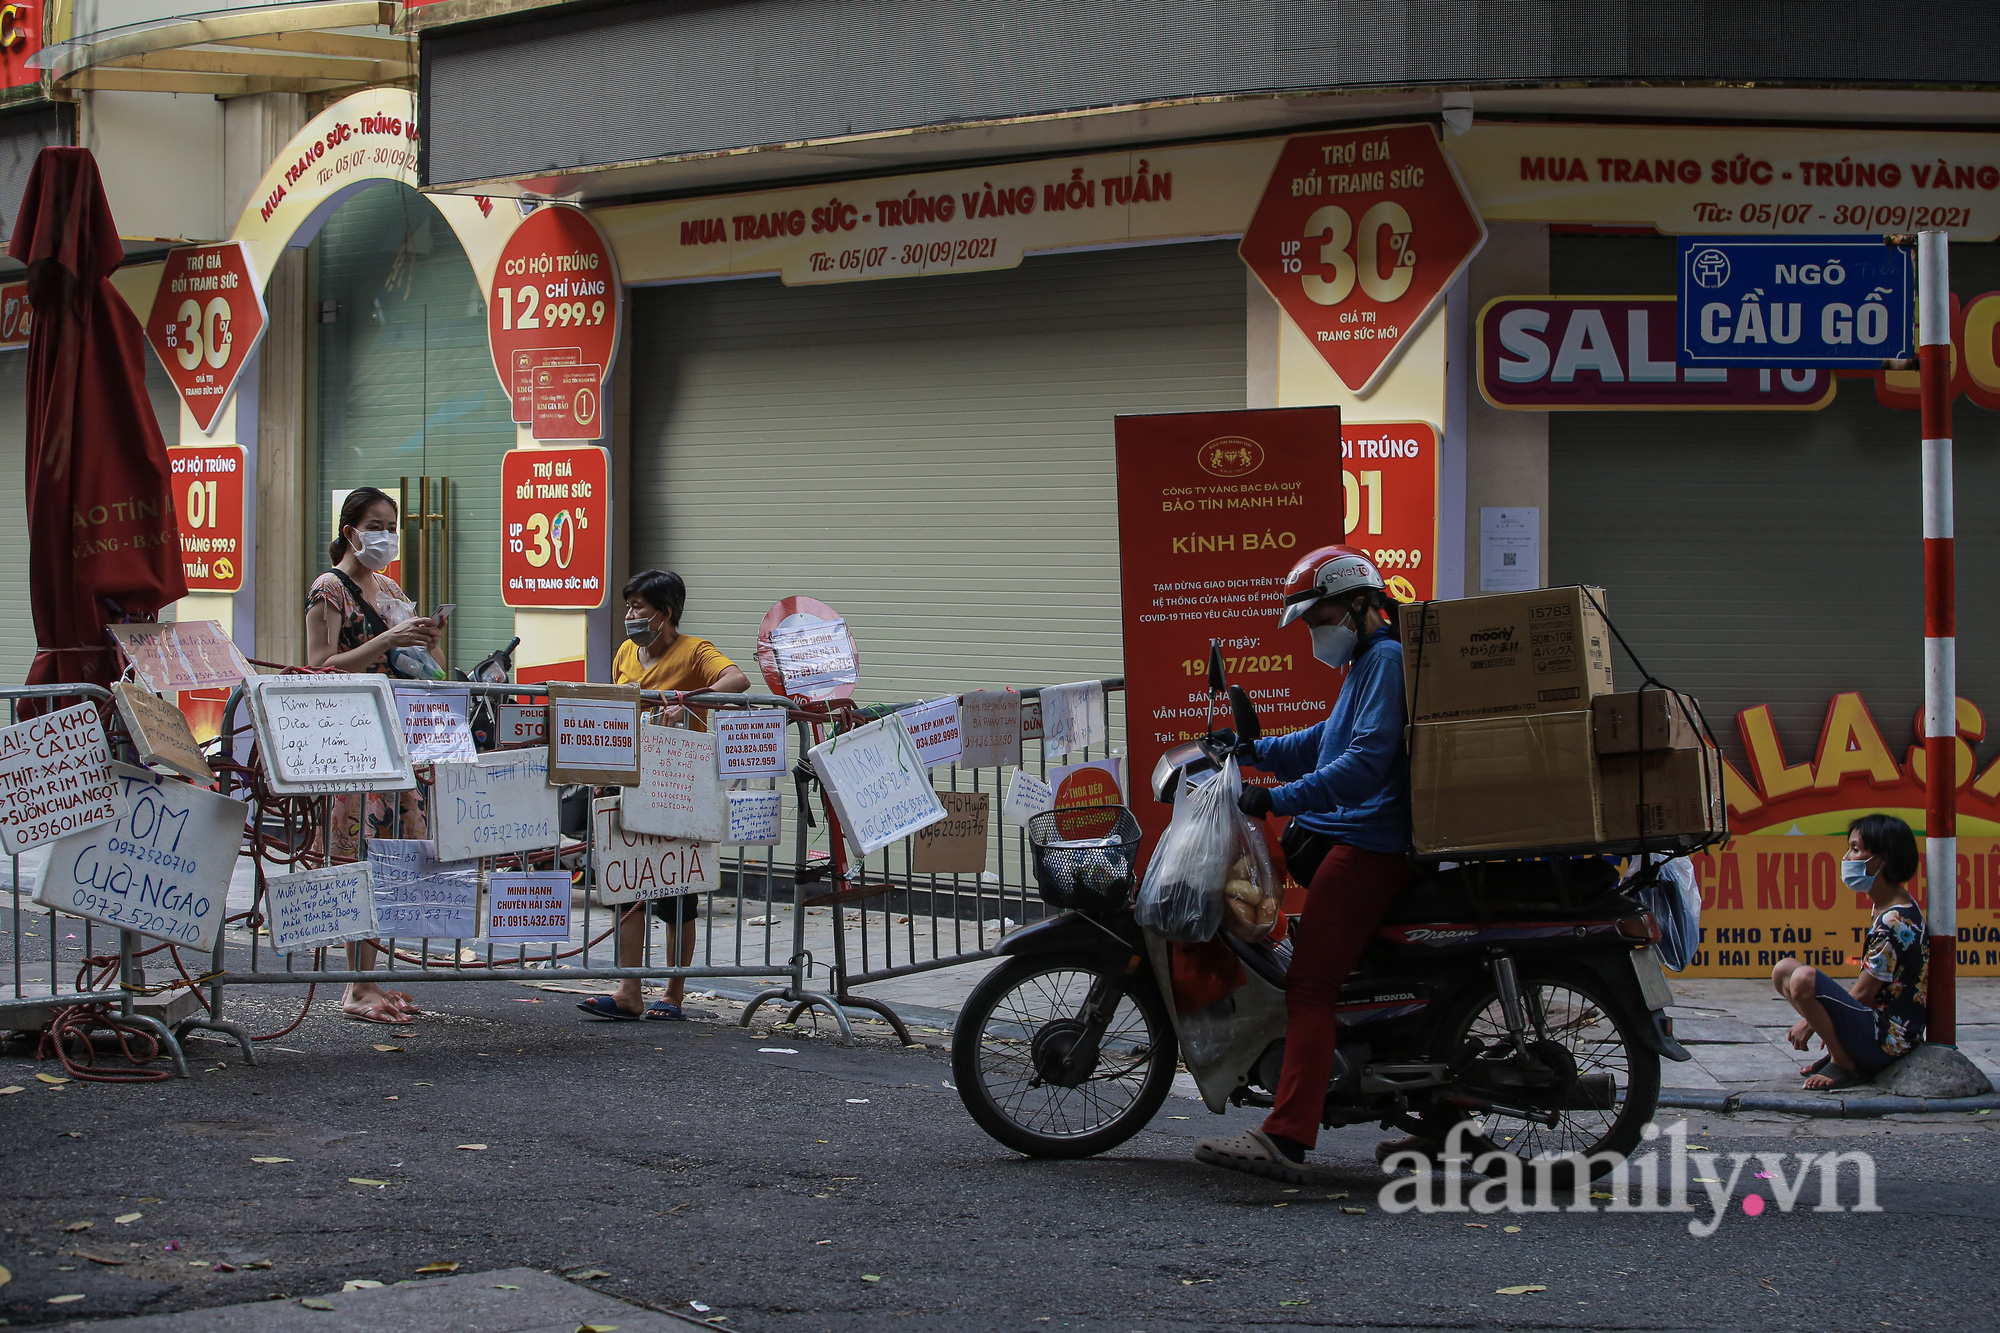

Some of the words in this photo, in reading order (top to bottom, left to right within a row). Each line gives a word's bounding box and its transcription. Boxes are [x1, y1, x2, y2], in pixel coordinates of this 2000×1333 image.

[1322, 141, 1356, 167] TRỢ
[1362, 136, 1391, 162] GIÁ
[261, 184, 287, 222] MUA
[285, 140, 324, 187] TRANG
[326, 123, 351, 149] SỨC
[360, 111, 401, 136] TRÚNG
[336, 149, 365, 174] 05/07
[1292, 168, 1322, 197] ĐỔI
[1328, 171, 1385, 195] TRANG
[1390, 164, 1425, 189] SỨC
[1520, 156, 1589, 182] MUA
[1597, 158, 1702, 184] TRANG
[1711, 153, 1773, 185] SỨC
[1800, 156, 1902, 188] TRÚNG
[1911, 158, 2000, 190] VÀNG
[680, 215, 727, 246] MUA
[732, 209, 806, 242] TRANG
[811, 198, 858, 235] SỨC
[876, 189, 955, 228] TRÚNG
[962, 181, 1037, 220] VÀNG
[1043, 168, 1095, 212] MỖI
[1101, 158, 1173, 206] TUẦN
[1740, 203, 1813, 229] 05/07
[1833, 205, 1971, 232] 30/09/2021
[839, 246, 889, 275] 05/07
[900, 237, 998, 270] 30/09/2021
[1281, 240, 1301, 256] UP
[186, 254, 204, 272] TRỢ
[206, 251, 222, 269] GIÁ
[505, 256, 526, 276] CƠ
[529, 252, 553, 278] HỘI
[556, 249, 599, 273] TRÚNG
[1282, 258, 1302, 274] TO
[189, 276, 218, 291] TRANG
[220, 271, 239, 289] SỨC
[1774, 258, 1846, 286] NGÕ
[546, 278, 568, 298] CHỈ
[571, 278, 605, 298] VÀNG
[498, 285, 540, 331] 12
[544, 300, 605, 328] 999.9
[1339, 310, 1358, 323] GIÁ
[1361, 312, 1376, 325] TRỊ
[1700, 287, 1802, 345] CẦU
[1820, 286, 1894, 345] GỖ
[166, 324, 177, 335] UP
[1317, 330, 1351, 342] TRANG
[1353, 327, 1375, 341] SỨC
[1377, 326, 1399, 339] MỚI
[166, 336, 177, 347] TO
[185, 388, 202, 396] TRANG
[1358, 434, 1419, 458] TRÚNG
[187, 457, 203, 476] HỘI
[205, 454, 236, 473] TRÚNG
[533, 461, 553, 480] TRỢ
[555, 459, 572, 477] GIÁ
[516, 479, 533, 499] ĐỔI
[536, 483, 568, 499] TRANG
[571, 479, 592, 498] SỨC
[1162, 486, 1193, 496] CÔNG
[1195, 486, 1207, 494] TY
[1209, 483, 1238, 494] VÀNG
[1240, 484, 1262, 494] BẠC
[1264, 481, 1278, 491] ĐÁ
[187, 480, 217, 529] 01
[1162, 498, 1195, 512] BẢO
[1198, 497, 1223, 510] TÍN
[1227, 496, 1273, 511] MẠNH
[1277, 493, 1303, 506] HẢI
[509, 523, 523, 537] UP
[185, 534, 211, 552] VÀNG
[211, 538, 237, 553] 999.9
[509, 539, 523, 553] TO
[1172, 532, 1235, 554] KÍNH
[1242, 528, 1296, 550] BÁO
[186, 557, 209, 578] TUẦN
[1374, 549, 1422, 569] 999.9
[509, 576, 523, 589] GIÁ
[525, 578, 536, 592] TRỊ
[537, 578, 563, 590] TRANG
[564, 575, 581, 589] SỨC
[583, 575, 599, 590] MỚI
[1153, 582, 1172, 592] TẠM
[1174, 579, 1202, 590] DỪNG
[1203, 579, 1226, 589] GIAO
[1227, 578, 1249, 590] DỊCH
[1250, 576, 1271, 587] TRÊN
[1152, 598, 1164, 608] HỆ
[1165, 593, 1197, 606] THỐNG
[1199, 592, 1219, 605] CỬA
[1220, 592, 1246, 604] HÀNG
[1247, 591, 1260, 602] ĐỂ
[1139, 613, 1178, 623] COVID-19
[1180, 611, 1203, 621] THEO
[1204, 609, 1222, 620] YÊU
[1222, 607, 1240, 619] CẦU
[1241, 606, 1259, 618] CỦA
[1529, 606, 1571, 619] 15783
[1229, 636, 1261, 650] ngày:
[1470, 625, 1515, 643] moony
[281, 697, 309, 711] Kim
[1188, 690, 1210, 703] BÁN
[1249, 688, 1291, 700] ONLINE
[1153, 706, 1176, 719] VẪN
[1179, 707, 1208, 719] HOẠT
[1277, 700, 1326, 712] THƯỜNG
[30, 716, 57, 742] CÁ
[59, 708, 97, 732] KHO
[735, 723, 749, 731] TƯƠI
[921, 722, 932, 731] TÉP
[933, 717, 945, 728] KIM
[945, 715, 956, 725] CHI
[560, 733, 574, 746] ĐT:
[576, 734, 632, 748] 093.612.9598
[916, 727, 959, 750] 034.682.9999
[1154, 732, 1174, 743] Tại:
[36, 736, 64, 759] CÁ
[725, 744, 777, 755] 0243.824.0596
[728, 756, 776, 768] 0914.572.959
[6, 785, 45, 807] TÔM
[1069, 787, 1087, 799] THOA
[17, 804, 115, 844] 0396011443
[1757, 851, 1836, 910] KHO
[507, 886, 527, 896] MINH
[497, 898, 527, 909] CHUYÊN
[493, 915, 506, 927] ĐT:
[508, 914, 566, 927] 0915.432.675
[1404, 929, 1480, 942] Dream
[1717, 927, 1761, 943] KHO
[1770, 922, 1811, 943] TÀU
[1719, 950, 1750, 966] HAI
[1805, 946, 1844, 965] TIÊU
[1374, 992, 1415, 1002] HONDA
